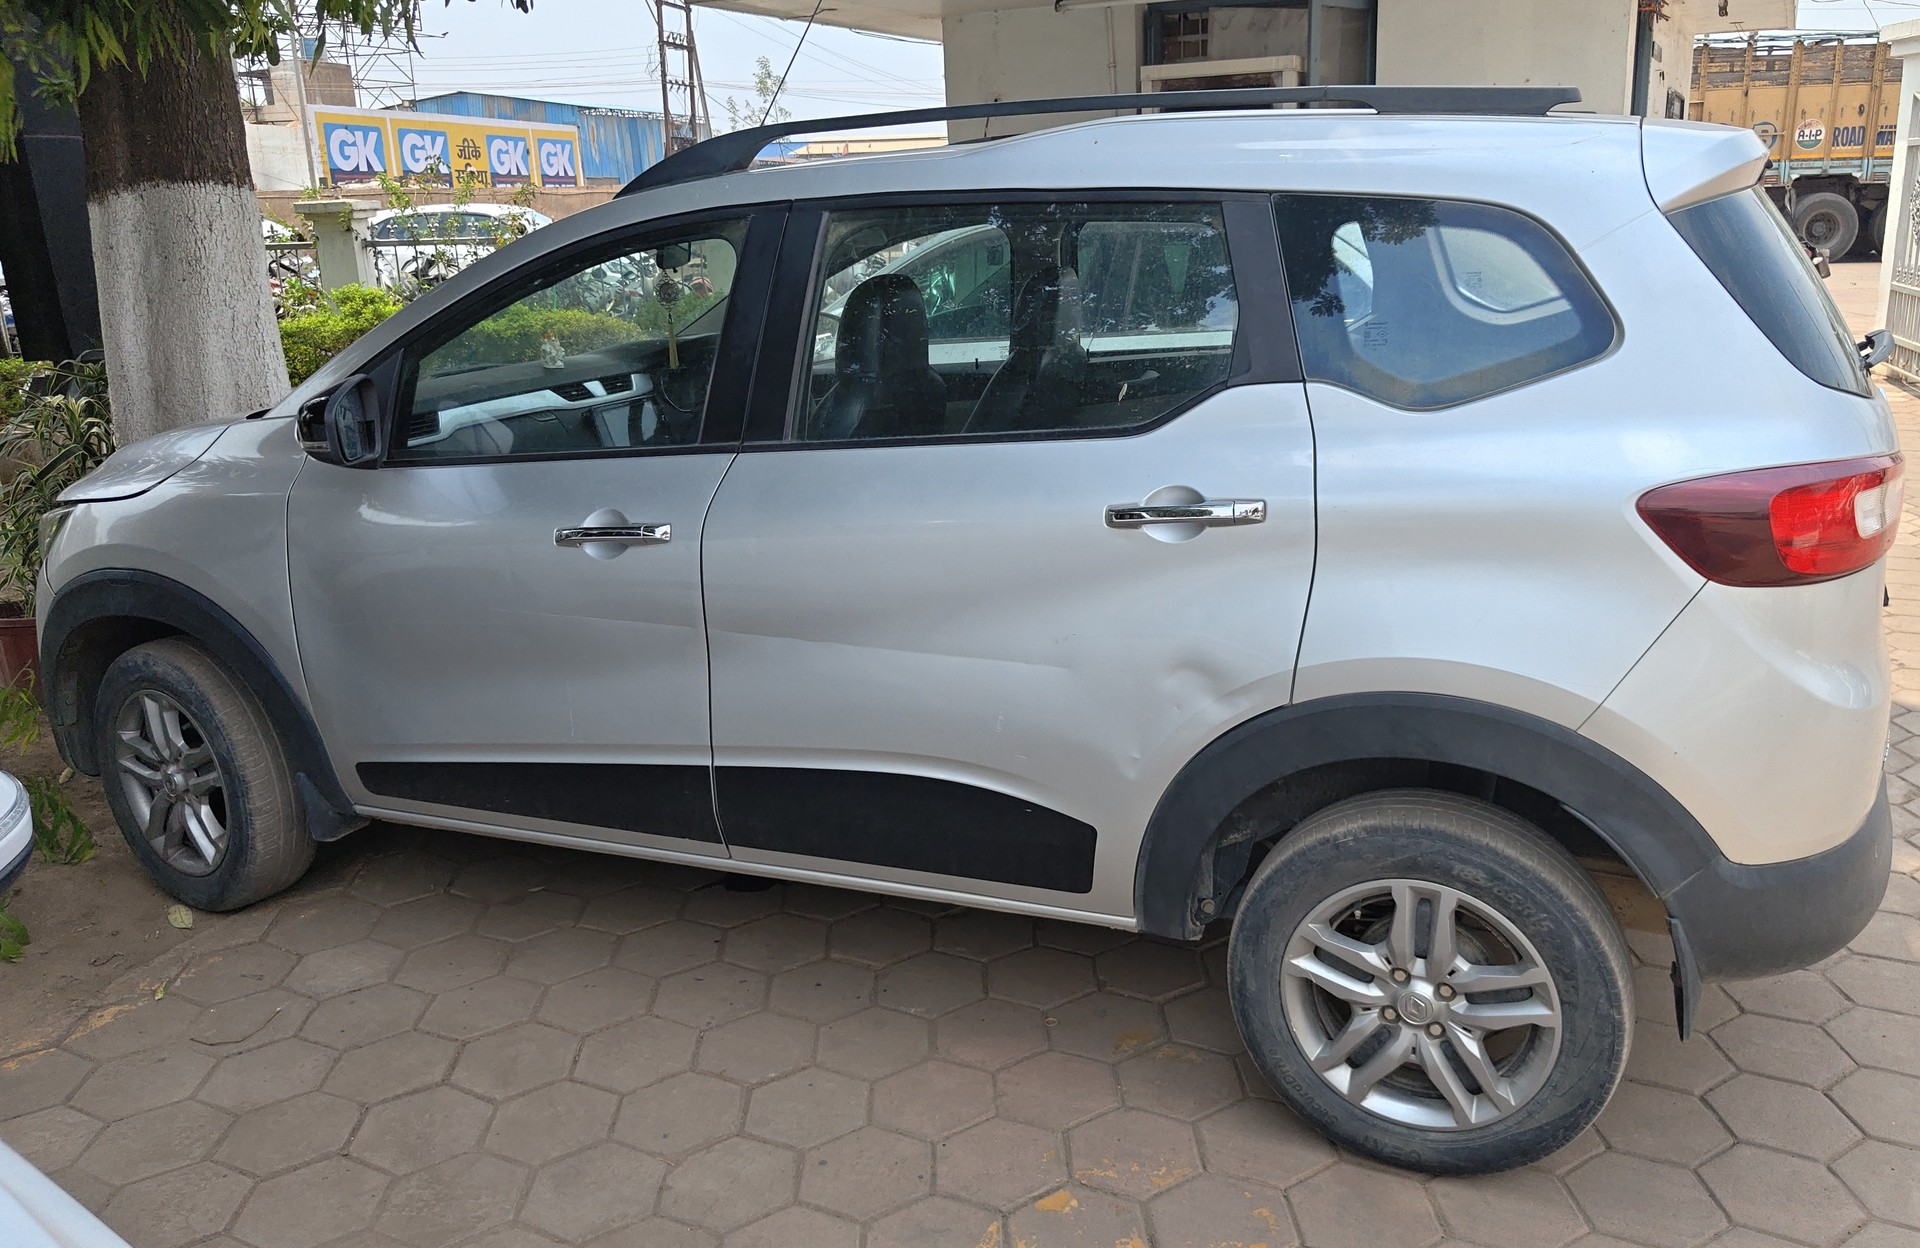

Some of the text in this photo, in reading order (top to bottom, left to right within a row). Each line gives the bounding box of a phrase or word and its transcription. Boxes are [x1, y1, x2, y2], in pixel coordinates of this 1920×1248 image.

[329, 128, 385, 171] GK
[402, 132, 450, 174] GK
[456, 137, 481, 160] जीके
[1832, 126, 1866, 147] ROAD
[490, 138, 529, 175] GK
[540, 142, 576, 176] GK
